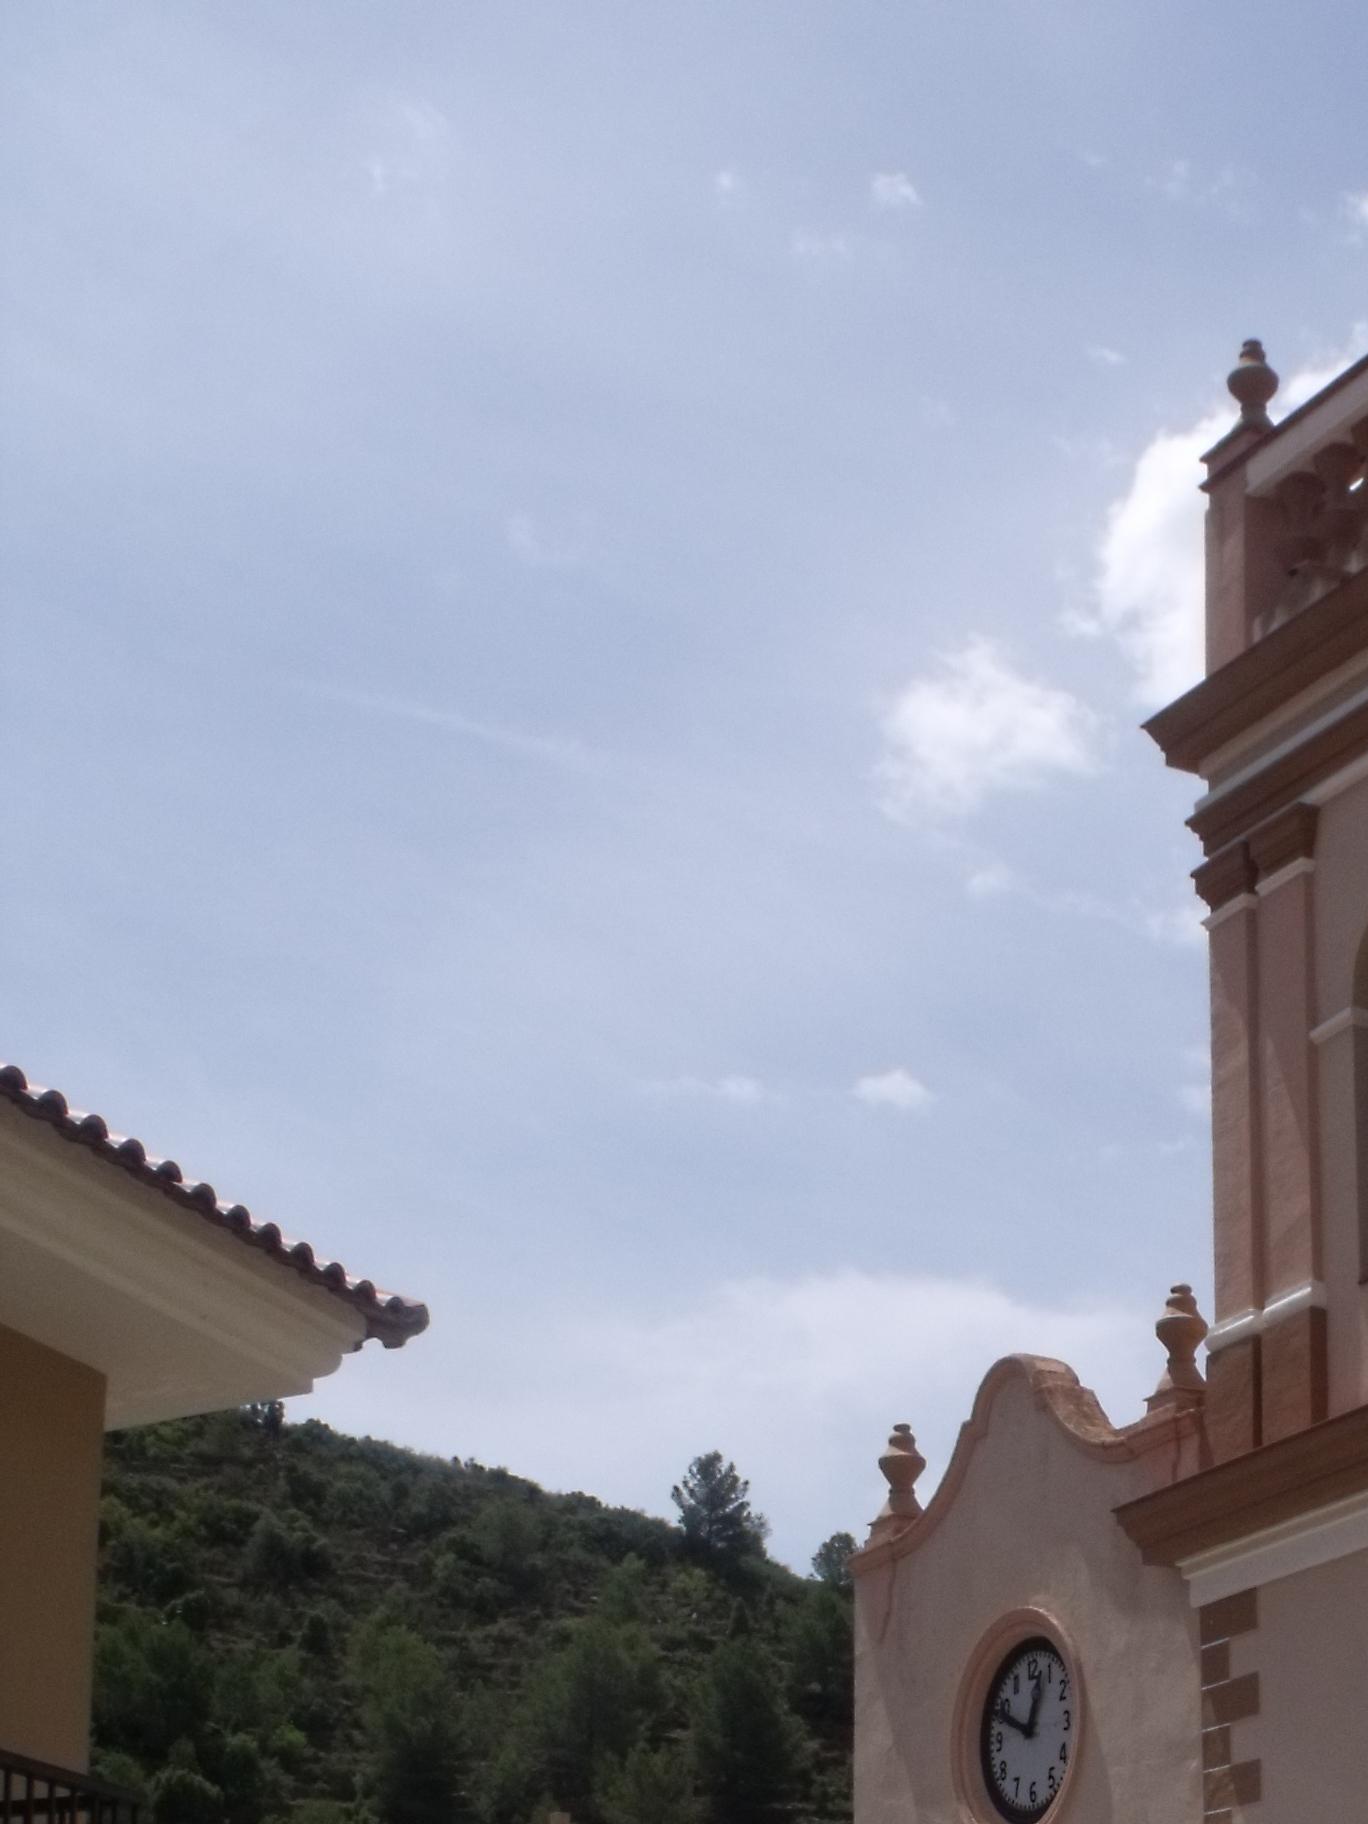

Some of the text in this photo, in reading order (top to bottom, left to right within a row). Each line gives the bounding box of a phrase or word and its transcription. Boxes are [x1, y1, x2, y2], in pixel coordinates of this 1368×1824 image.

[1028, 1659, 1039, 1681] 12
[1059, 1679, 1067, 1702] 2
[1063, 1710, 1071, 1731] 3
[996, 1732, 1003, 1753] 9
[1059, 1743, 1067, 1764] 4
[999, 1760, 1007, 1781] 8
[1049, 1767, 1056, 1789] 5
[1014, 1777, 1020, 1798] 7
[1029, 1782, 1037, 1803] 6
